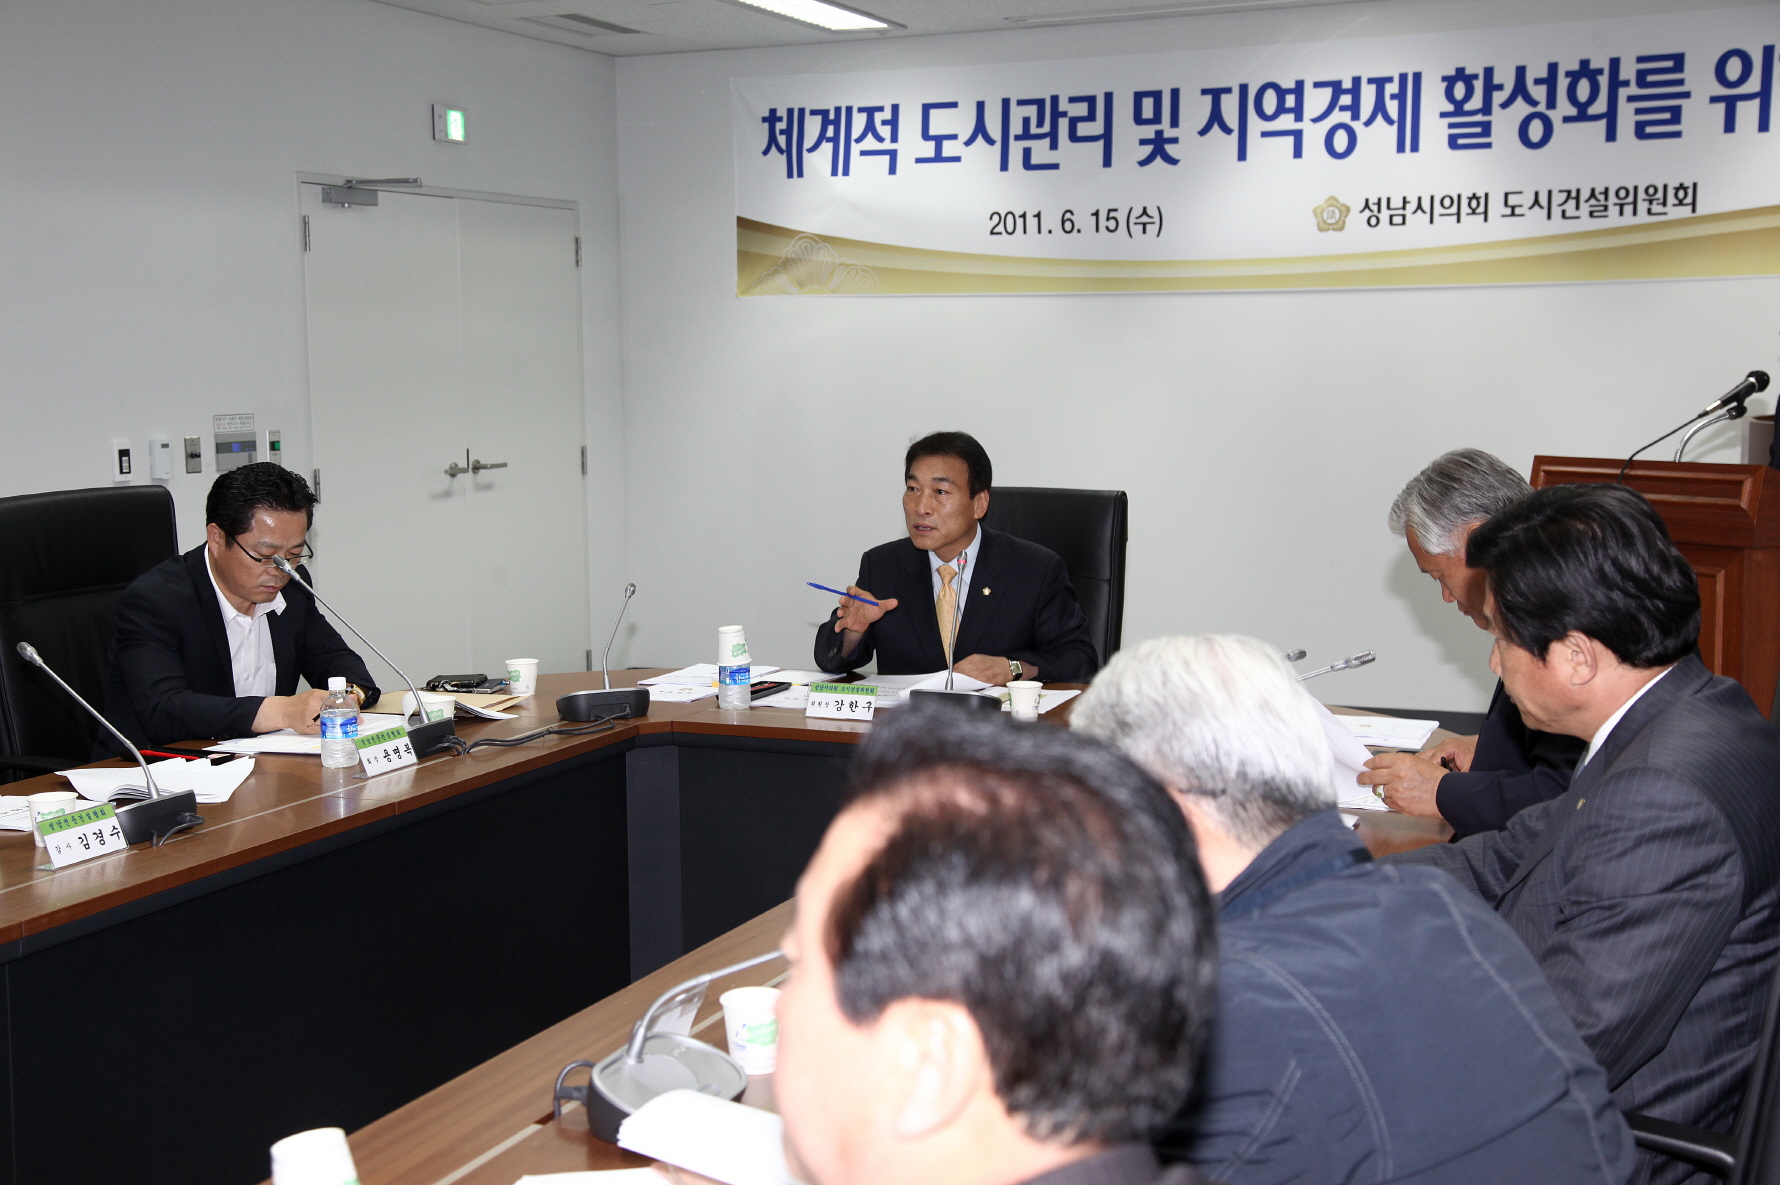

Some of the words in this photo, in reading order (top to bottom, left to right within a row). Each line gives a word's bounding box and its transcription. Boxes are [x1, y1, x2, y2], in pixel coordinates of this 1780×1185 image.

[761, 103, 899, 179] 체계적
[914, 91, 1114, 172] 도시관리
[1132, 87, 1181, 168] 및
[1196, 71, 1423, 162] 지역경제
[1438, 53, 1692, 151] 활성화를
[1709, 44, 1780, 134] 위
[988, 209, 1053, 236] 2011.
[1060, 209, 1082, 234] 6.
[1358, 192, 1490, 228] 성남시의회
[1500, 181, 1699, 223] 도시건설위원회
[77, 824, 121, 850] 김경수
